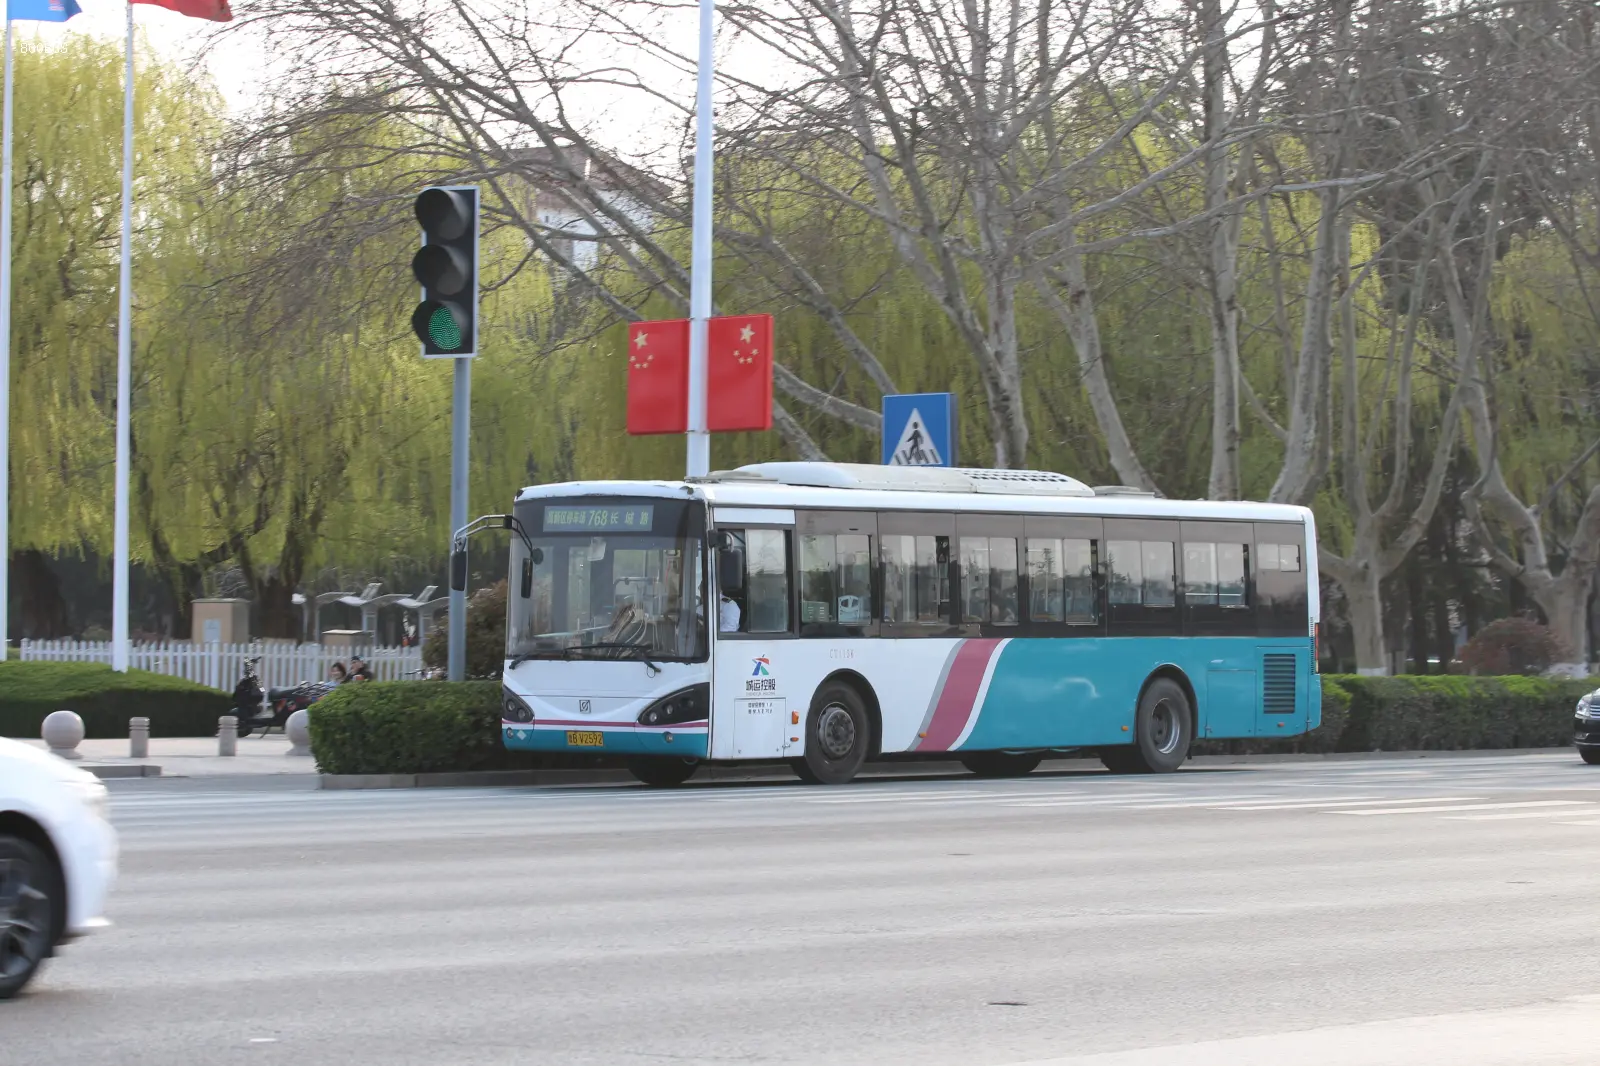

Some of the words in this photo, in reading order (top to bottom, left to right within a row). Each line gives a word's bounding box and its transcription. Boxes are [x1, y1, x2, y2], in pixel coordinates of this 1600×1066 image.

[588, 510, 609, 526] 768
[746, 678, 776, 691] 城运控股
